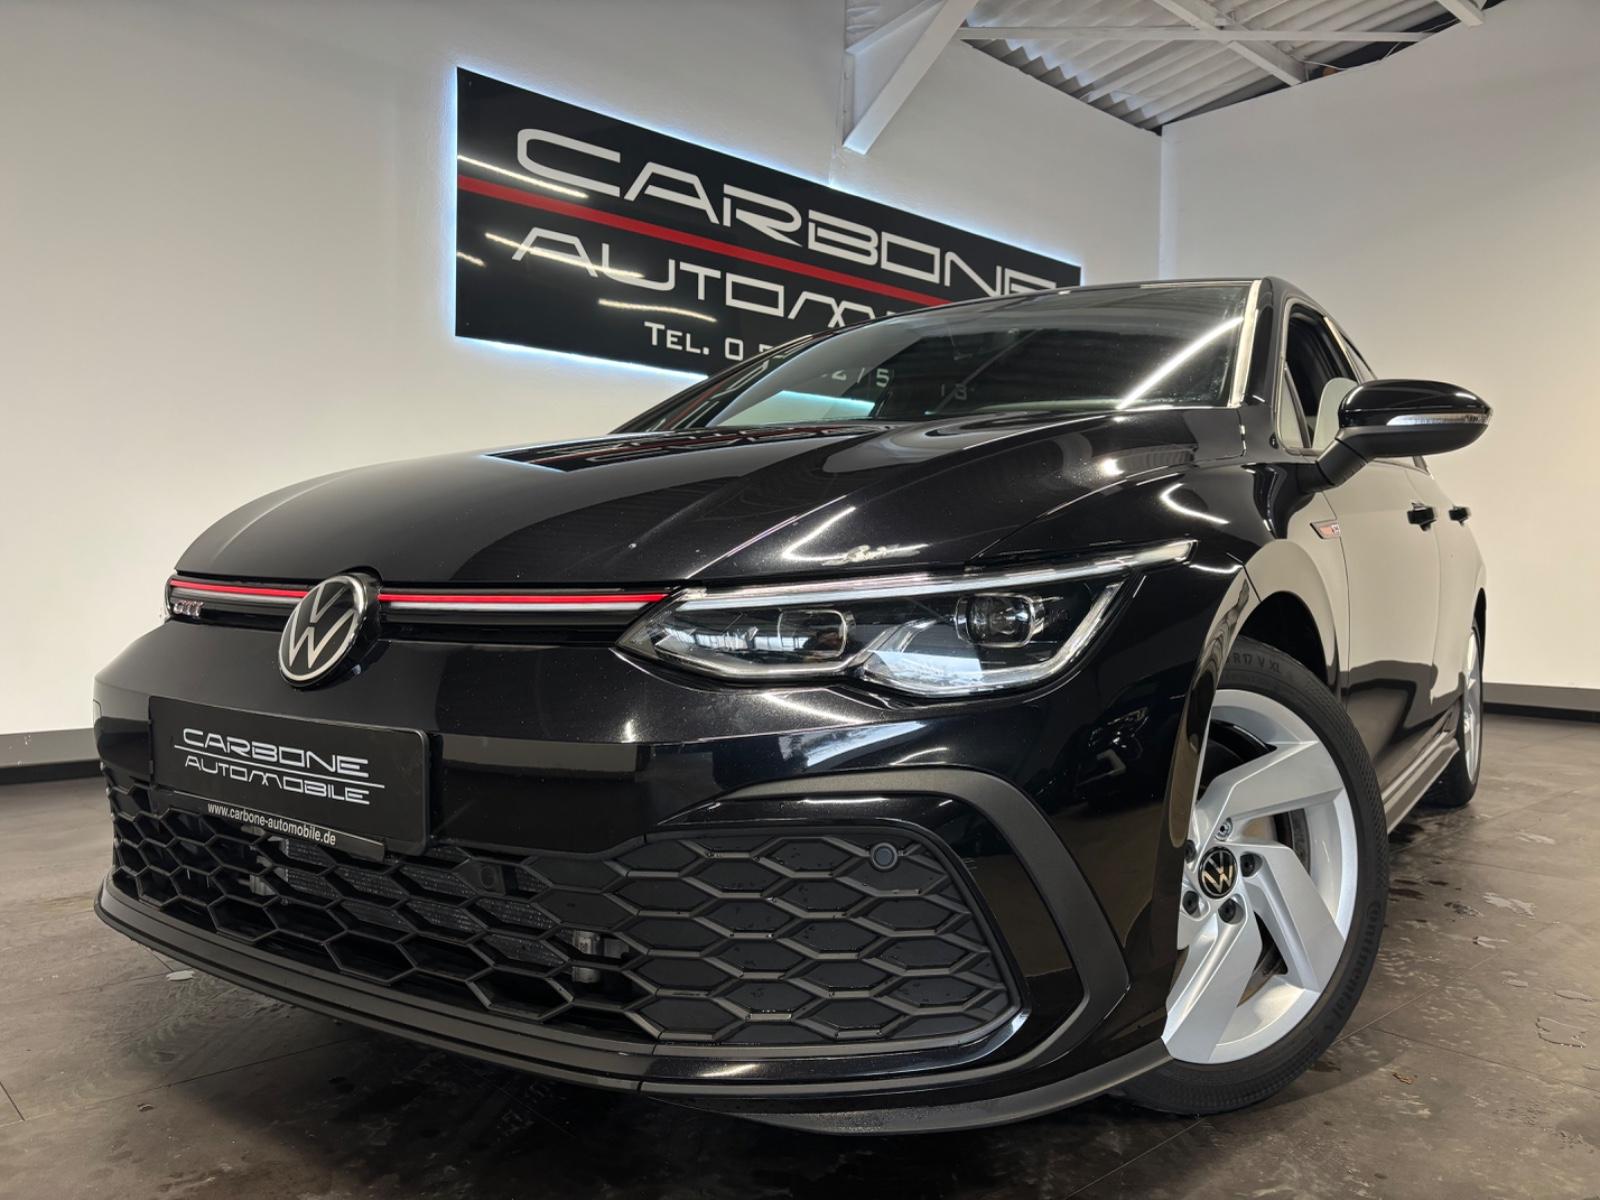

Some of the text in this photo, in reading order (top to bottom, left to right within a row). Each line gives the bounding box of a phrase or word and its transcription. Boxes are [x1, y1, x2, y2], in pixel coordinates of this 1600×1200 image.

[516, 128, 1057, 298] CARBONE
[511, 226, 897, 330] AUTOM
[644, 321, 710, 356] TEL.
[183, 728, 369, 778] CARBONE
[185, 755, 370, 805] AUTOMOBILE
[207, 802, 336, 846] www.carbone-automobile.de
